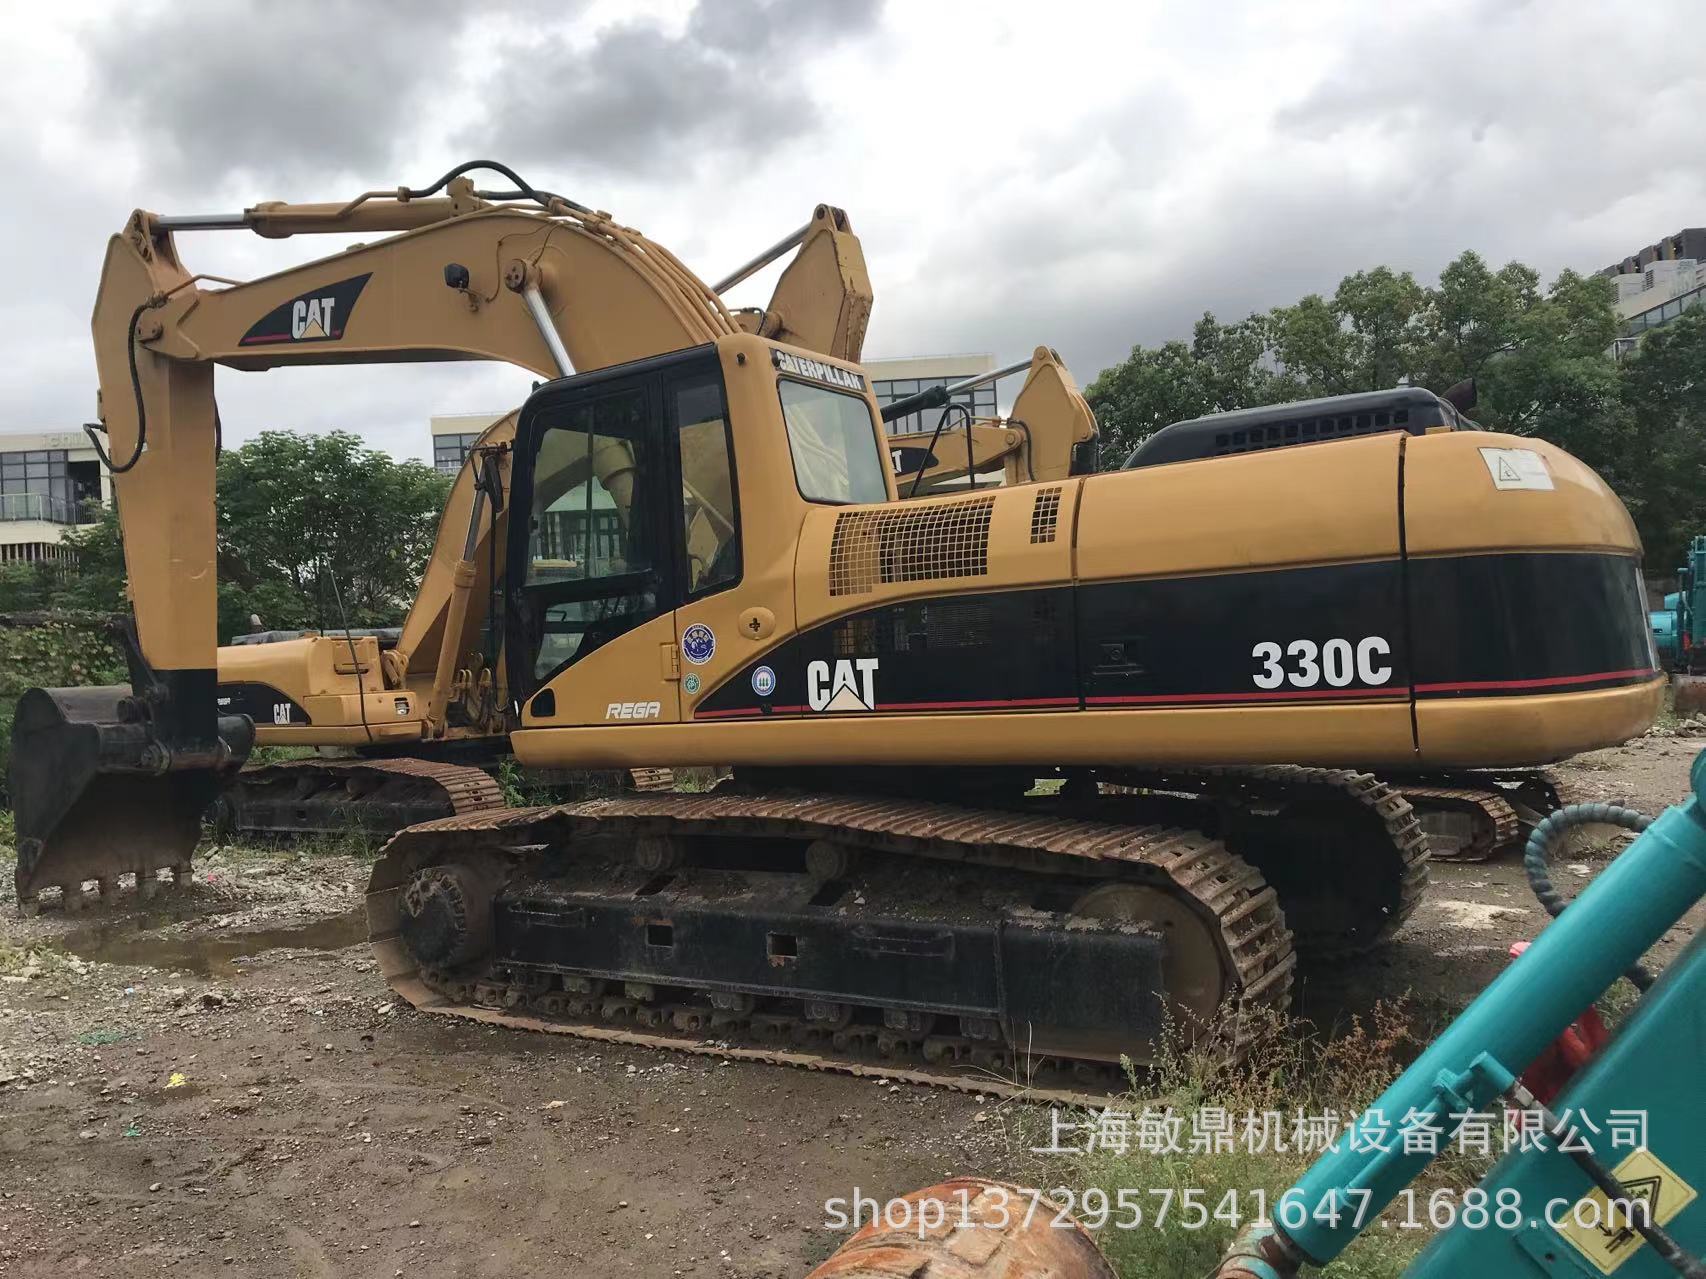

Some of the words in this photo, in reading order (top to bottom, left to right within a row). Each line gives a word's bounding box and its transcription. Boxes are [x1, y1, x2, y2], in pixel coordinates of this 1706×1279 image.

[292, 297, 335, 339] CAT
[1252, 636, 1393, 690] 330C
[807, 657, 879, 712] CAT
[273, 703, 291, 725] CAT
[605, 702, 661, 720] REGA
